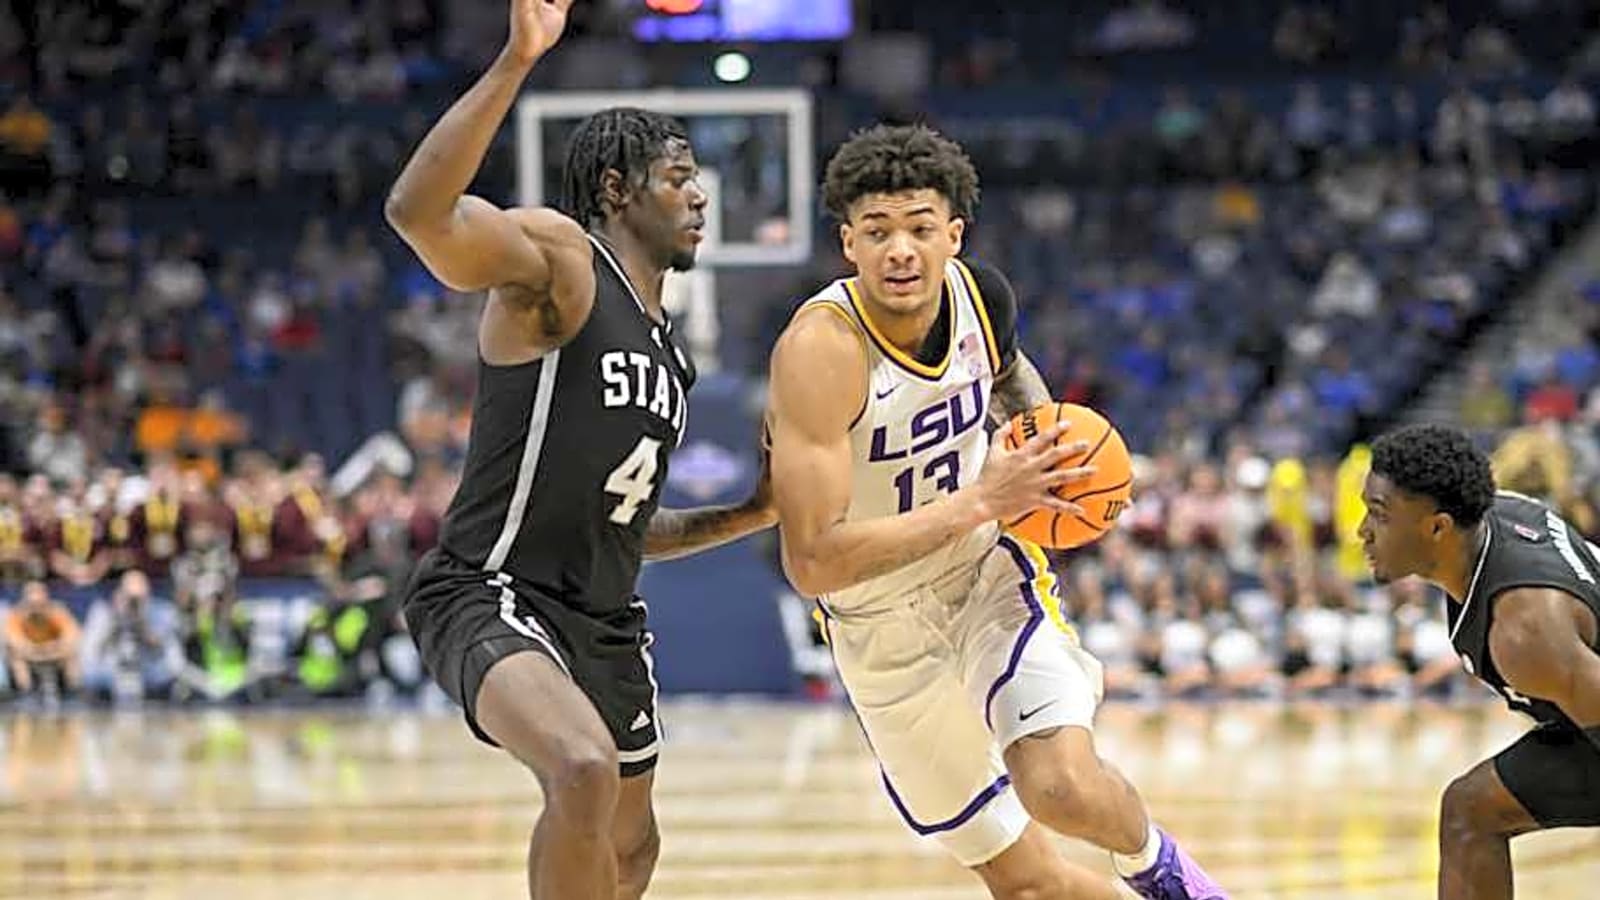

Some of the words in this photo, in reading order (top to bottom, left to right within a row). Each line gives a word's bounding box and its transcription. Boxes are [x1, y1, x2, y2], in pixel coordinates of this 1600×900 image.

[869, 379, 983, 462] LSU
[604, 435, 662, 525] 4
[894, 450, 960, 515] 13
